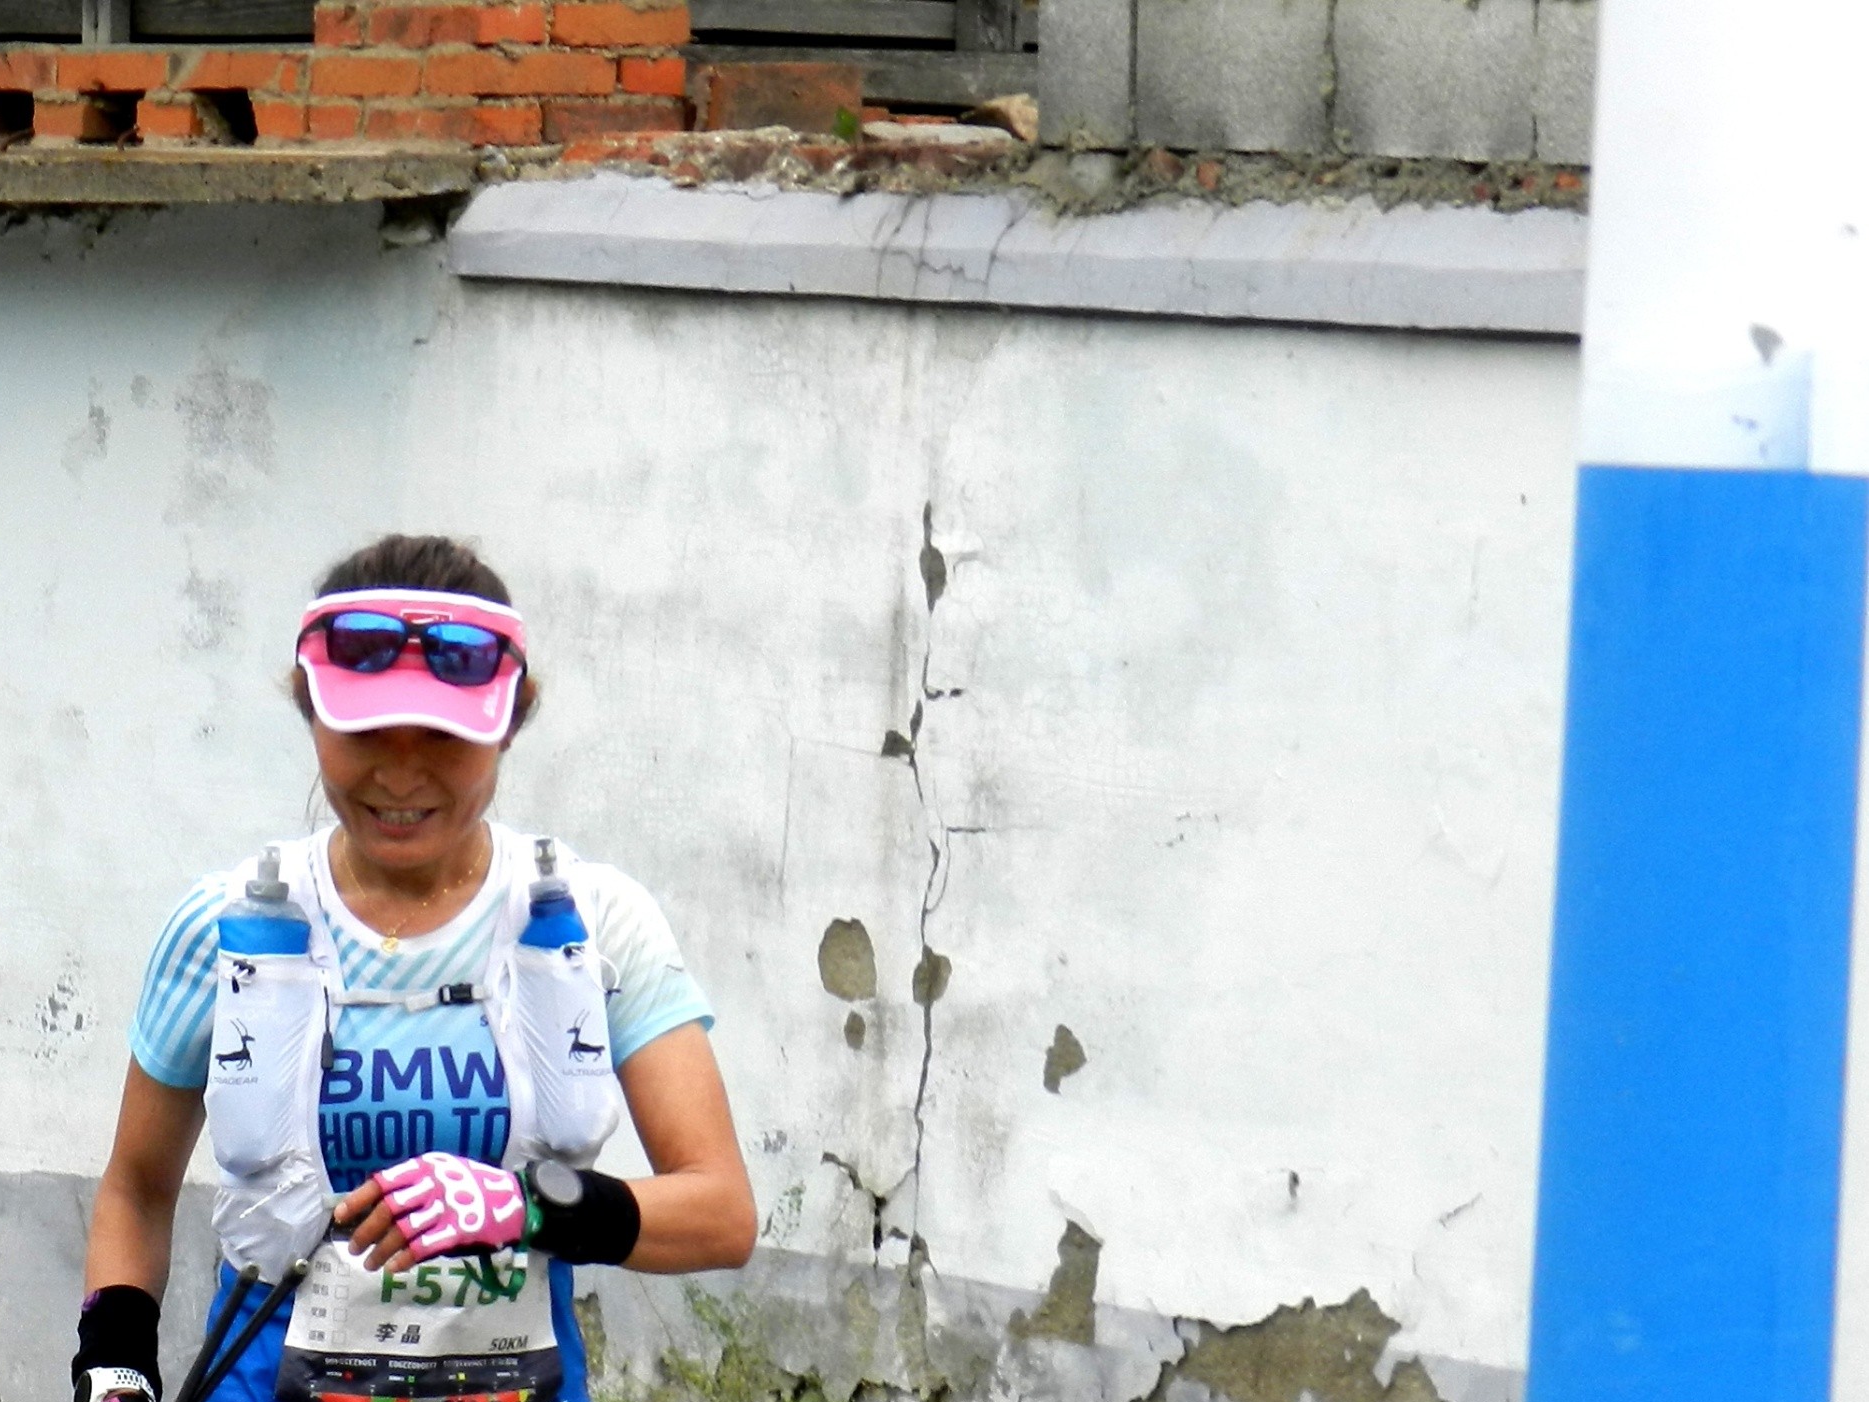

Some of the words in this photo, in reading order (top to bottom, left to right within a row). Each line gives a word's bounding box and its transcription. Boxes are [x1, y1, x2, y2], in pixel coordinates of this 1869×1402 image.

[320, 1046, 506, 1104] BMW
[319, 1109, 434, 1167] HOOD
[488, 1334, 528, 1351] 50KM
